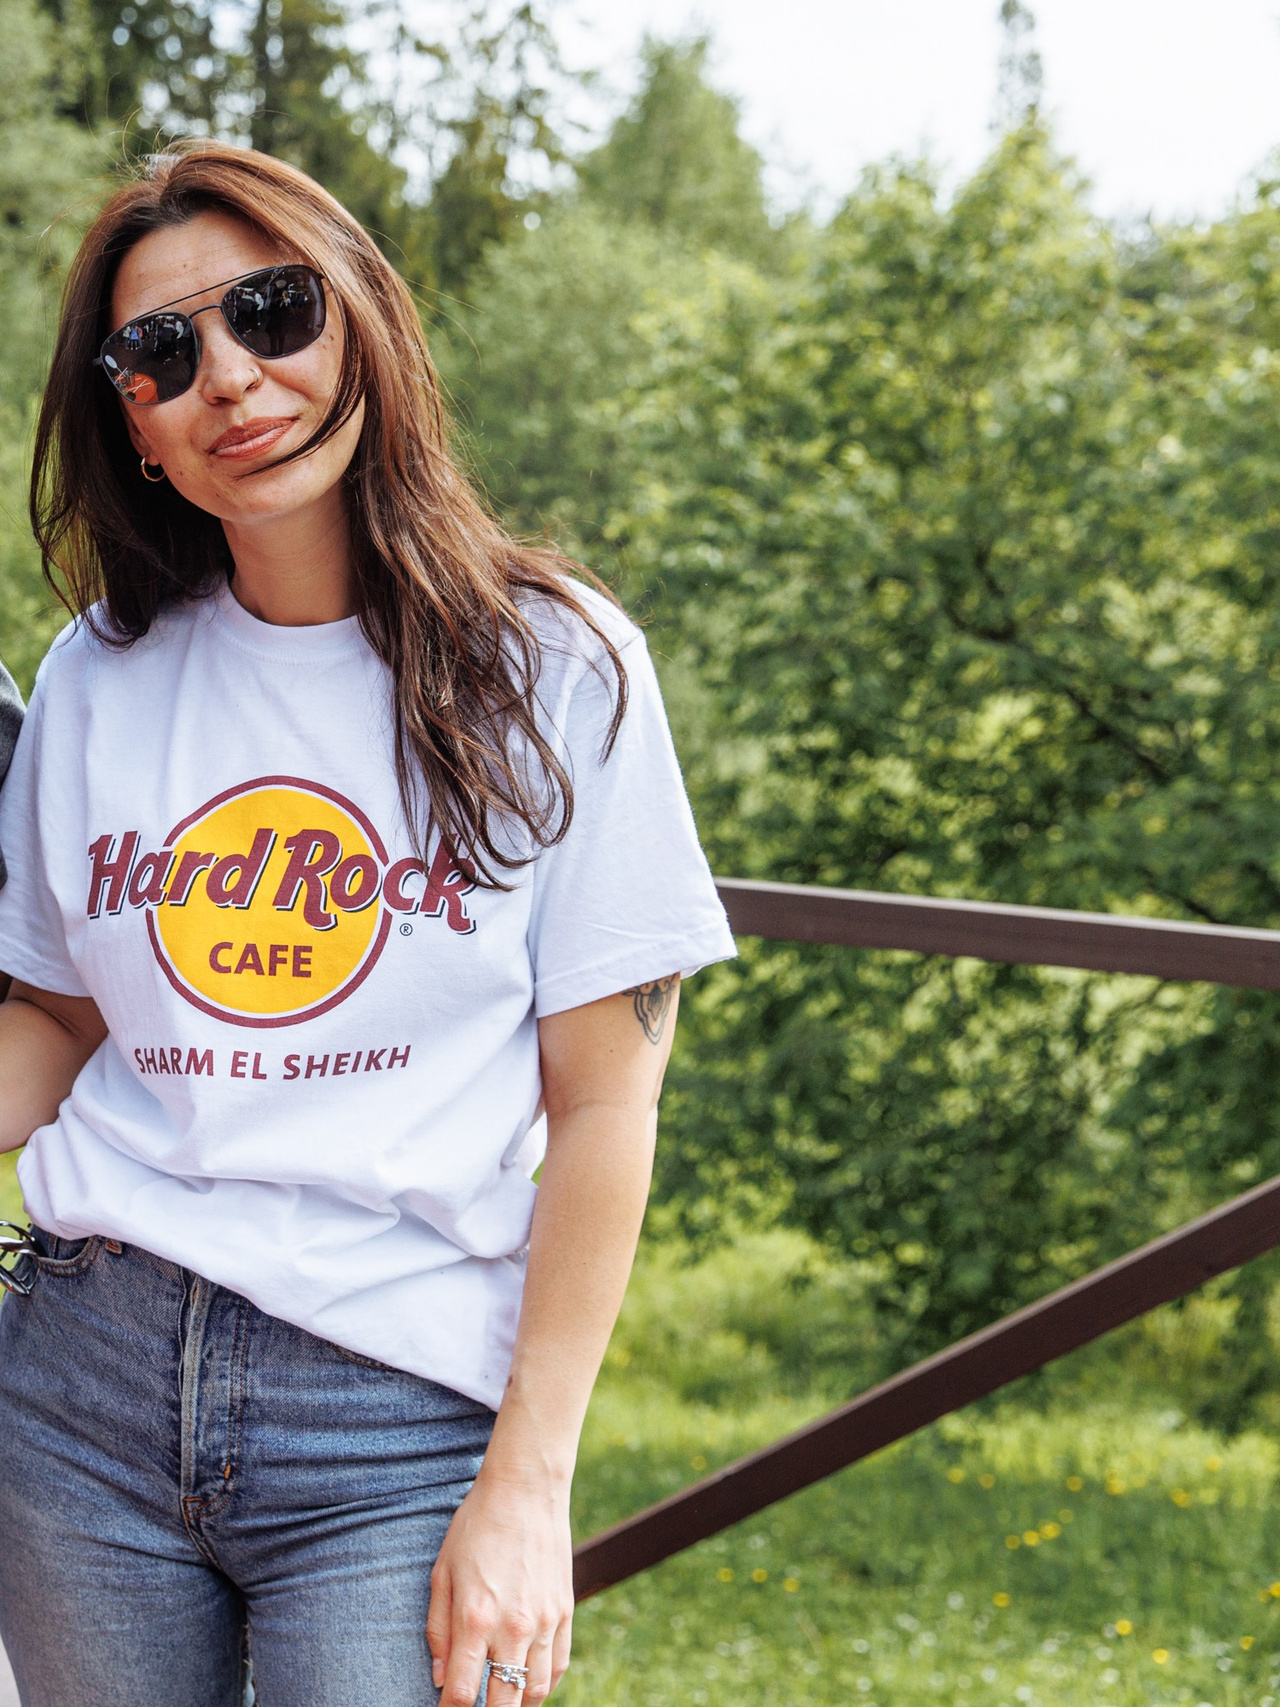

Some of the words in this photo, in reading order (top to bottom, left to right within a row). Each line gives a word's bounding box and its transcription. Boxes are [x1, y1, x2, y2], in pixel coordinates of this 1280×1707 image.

[87, 828, 275, 918] Hard
[273, 829, 477, 935] Rock
[208, 941, 313, 978] CAFE
[133, 1046, 215, 1077] SHARM
[230, 1050, 268, 1080] EL
[282, 1044, 412, 1080] SHEIKH
